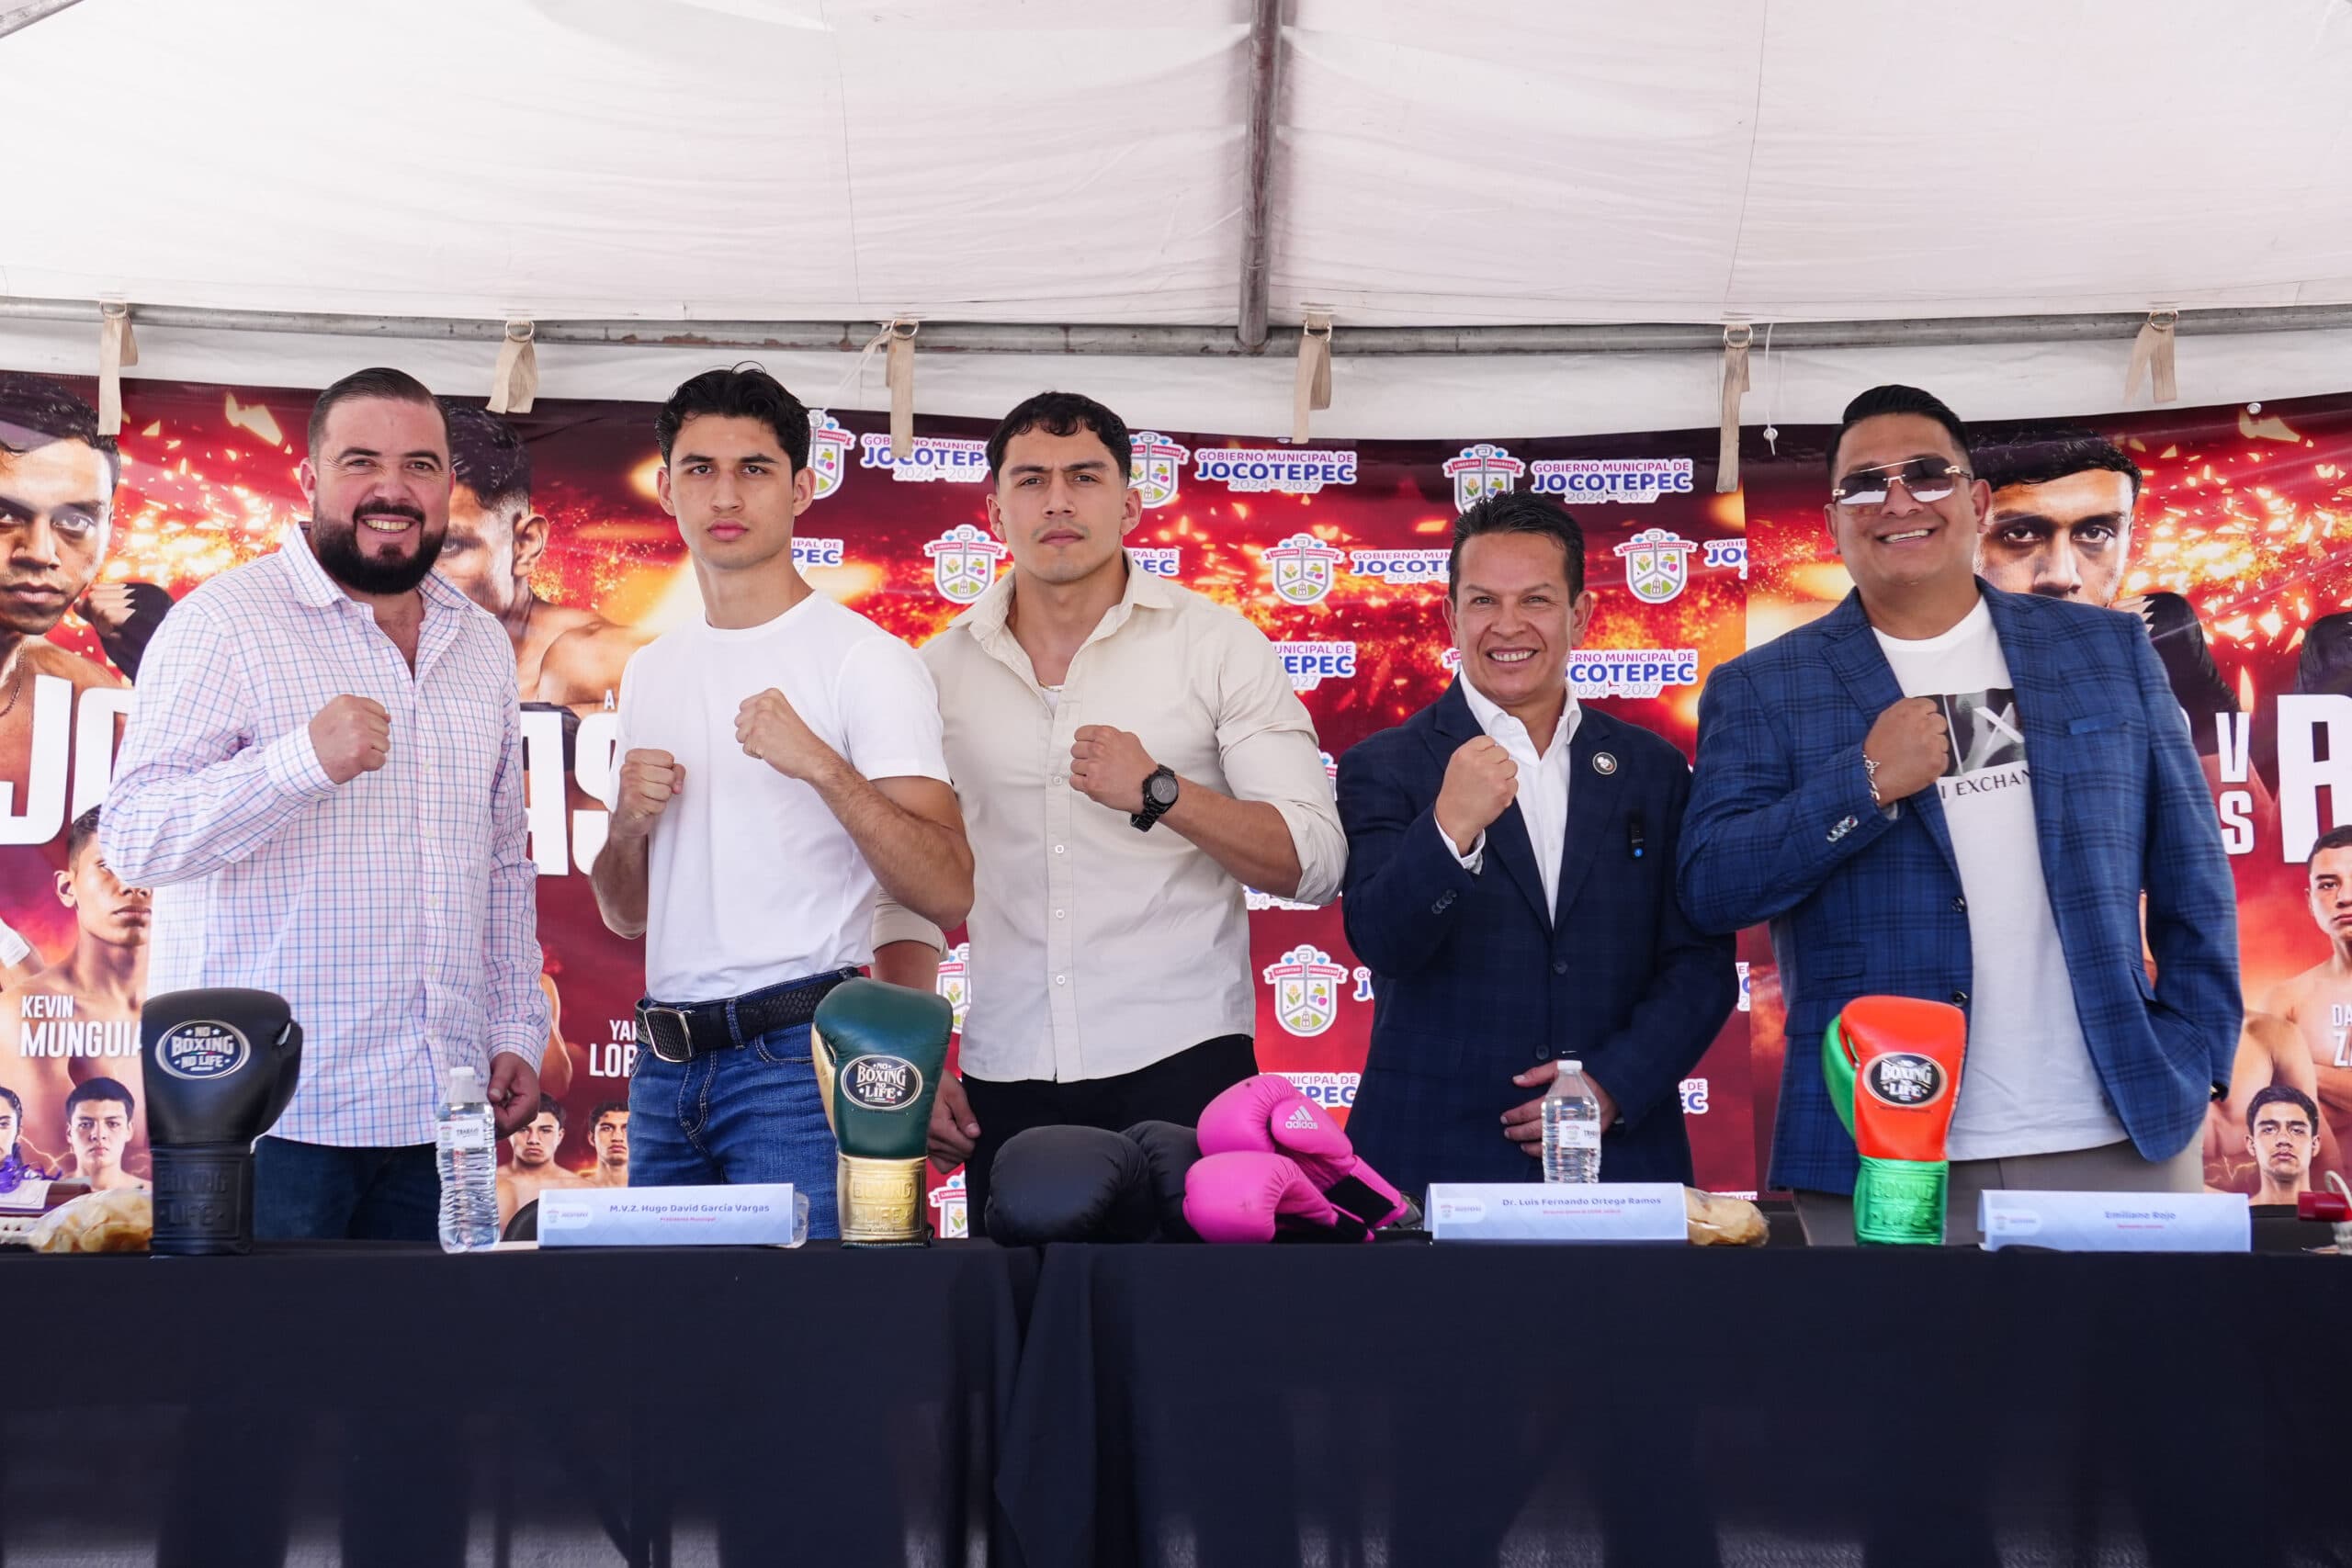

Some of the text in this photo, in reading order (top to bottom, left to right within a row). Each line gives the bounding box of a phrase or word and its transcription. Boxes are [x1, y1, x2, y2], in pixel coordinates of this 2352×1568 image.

[864, 435, 984, 451] GOBNO MUNICIP
[1198, 451, 1353, 462] GOBIERNO MUNICIPAL DE
[1198, 462, 1354, 482] JOCOTEPEC
[1533, 462, 1690, 473] GOBIERNO MUNICIPAL DE
[1533, 472, 1690, 491] JOCOTEPEC
[824, 541, 840, 549] DE
[1707, 540, 1747, 548] GOBIE
[1159, 551, 1176, 559] DE
[1353, 560, 1451, 574] JOCOT
[1275, 645, 1352, 654] UNICIPAL DE
[1605, 653, 1674, 662] MUNICIPAL
[1678, 652, 1694, 661] DE
[1566, 663, 1694, 682] COTEPEC
[21, 995, 74, 1018] KEVIN
[194, 1026, 211, 1037] NO
[171, 1034, 235, 1057] BOXING
[181, 1055, 224, 1068] NO LIFE
[856, 1064, 907, 1087] BOXING
[1880, 1061, 1932, 1085] BOXING
[1340, 1076, 1357, 1085] DE
[1687, 1081, 1704, 1091] DE
[865, 1085, 897, 1099] LIFE
[1889, 1082, 1923, 1098] LIFE
[1285, 1120, 1318, 1130] adidas
[1520, 1198, 1539, 1206] Luis
[1542, 1197, 1589, 1206] Fernando
[1591, 1197, 1626, 1206] Ortega
[1628, 1197, 1662, 1205] Ramos
[642, 1204, 668, 1213] Hugo
[670, 1203, 698, 1213] David
[701, 1202, 733, 1213] García
[735, 1204, 770, 1214] Vargas
